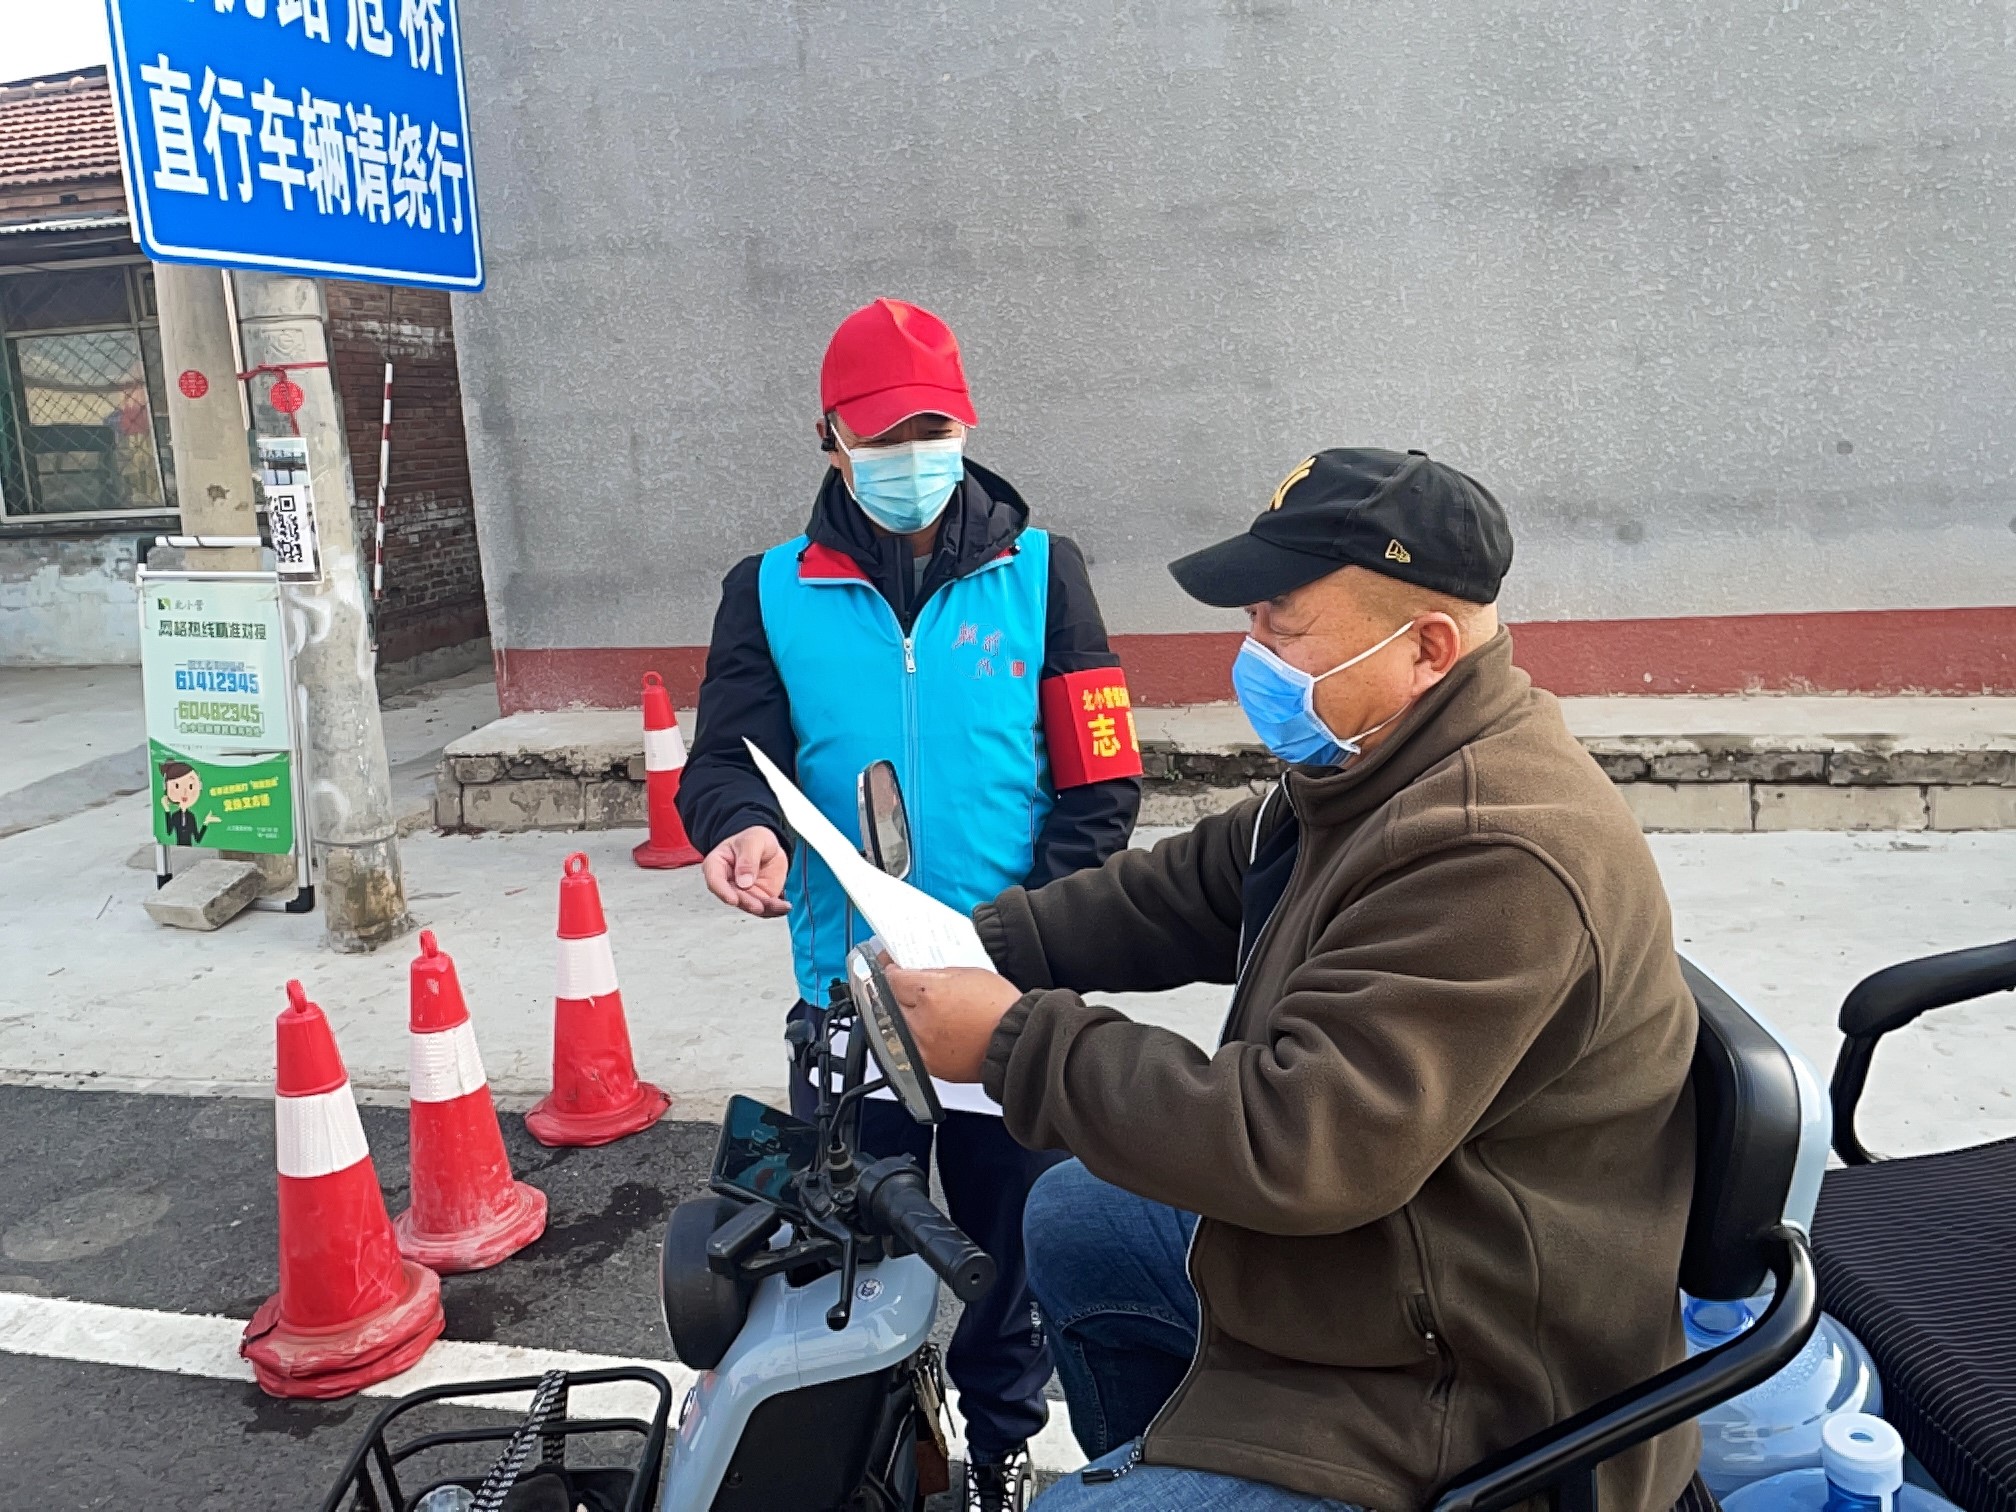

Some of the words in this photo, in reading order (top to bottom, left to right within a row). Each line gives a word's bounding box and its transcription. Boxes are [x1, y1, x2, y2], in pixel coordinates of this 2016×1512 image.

[140, 54, 463, 235] 直行车辆请绕行
[175, 671, 259, 694] 61412345
[178, 701, 261, 723] 60482345
[1087, 713, 1139, 758] 志
